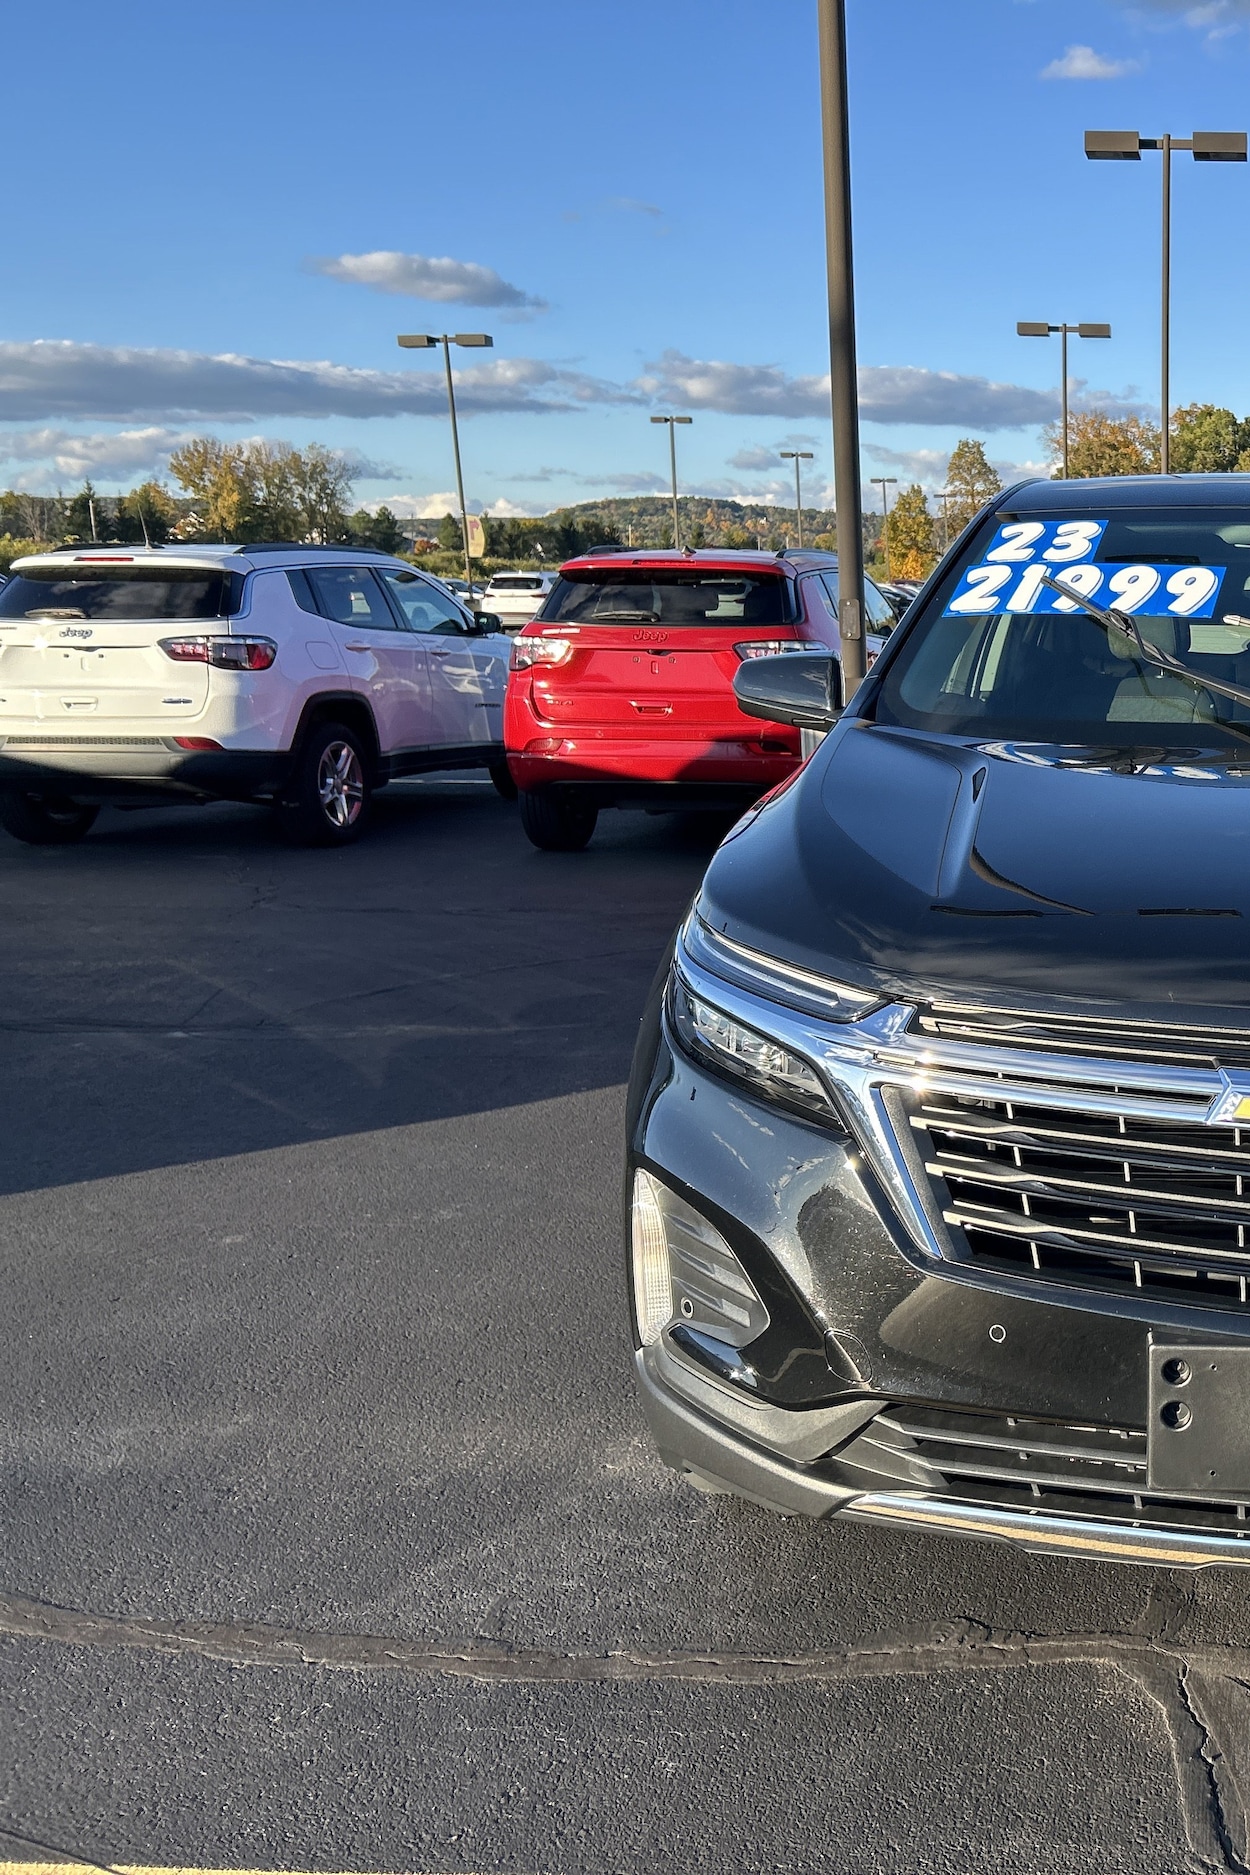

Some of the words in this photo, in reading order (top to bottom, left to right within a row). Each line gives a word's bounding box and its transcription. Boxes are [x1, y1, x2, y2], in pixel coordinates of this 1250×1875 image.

[986, 521, 1103, 563] 23
[948, 563, 1219, 616] 21999
[59, 626, 93, 640] Jeep
[632, 628, 668, 643] Jeep
